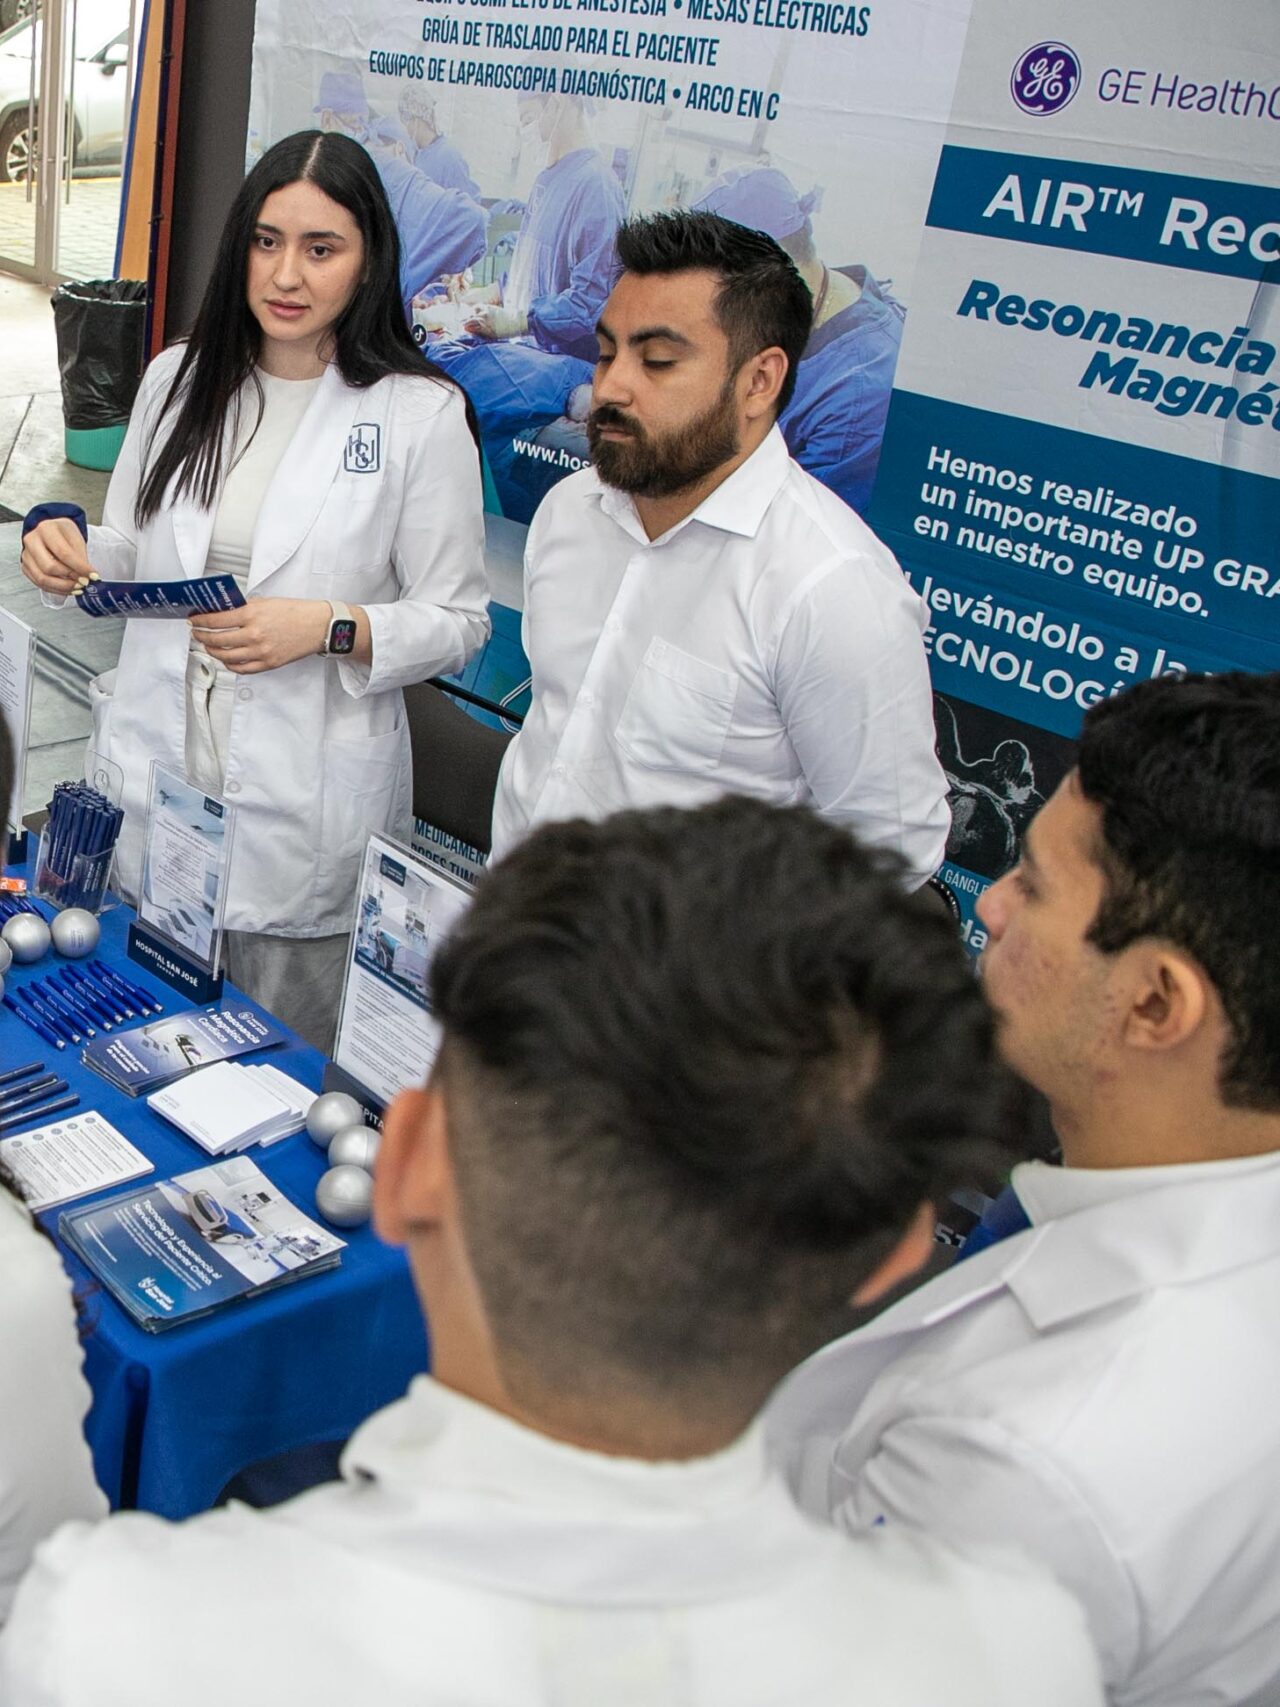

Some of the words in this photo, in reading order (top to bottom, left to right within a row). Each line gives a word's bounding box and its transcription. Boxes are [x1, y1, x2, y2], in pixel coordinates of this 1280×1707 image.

[422, 15, 459, 45] GRÚA
[463, 20, 482, 47] DE
[485, 22, 563, 51] TRASLADO
[566, 27, 608, 55] PARA
[612, 30, 631, 58] EL
[635, 32, 720, 66] PACIENTE
[687, 0, 750, 24] MESAS
[369, 50, 425, 80] EQUIPOS
[428, 57, 447, 83] DE
[448, 60, 557, 93] LAPAROSCOPIA
[560, 68, 667, 105] DIAGNÓSTICA
[685, 82, 734, 114] ARCO
[737, 89, 764, 119] EN
[765, 93, 780, 121] C
[1098, 68, 1147, 104] GE
[956, 279, 1277, 376] Resonancia
[927, 446, 1033, 494] Hemos
[1041, 479, 1197, 538] realizado
[921, 483, 957, 510] un
[964, 490, 1142, 559] importante
[1153, 540, 1205, 574] UP
[914, 515, 949, 541] en
[957, 527, 1074, 575] nuestro
[1083, 563, 1209, 618] equipo.
[1114, 647, 1139, 674] a
[135, 939, 165, 965] HOSPITAL
[166, 960, 180, 975] SAN
